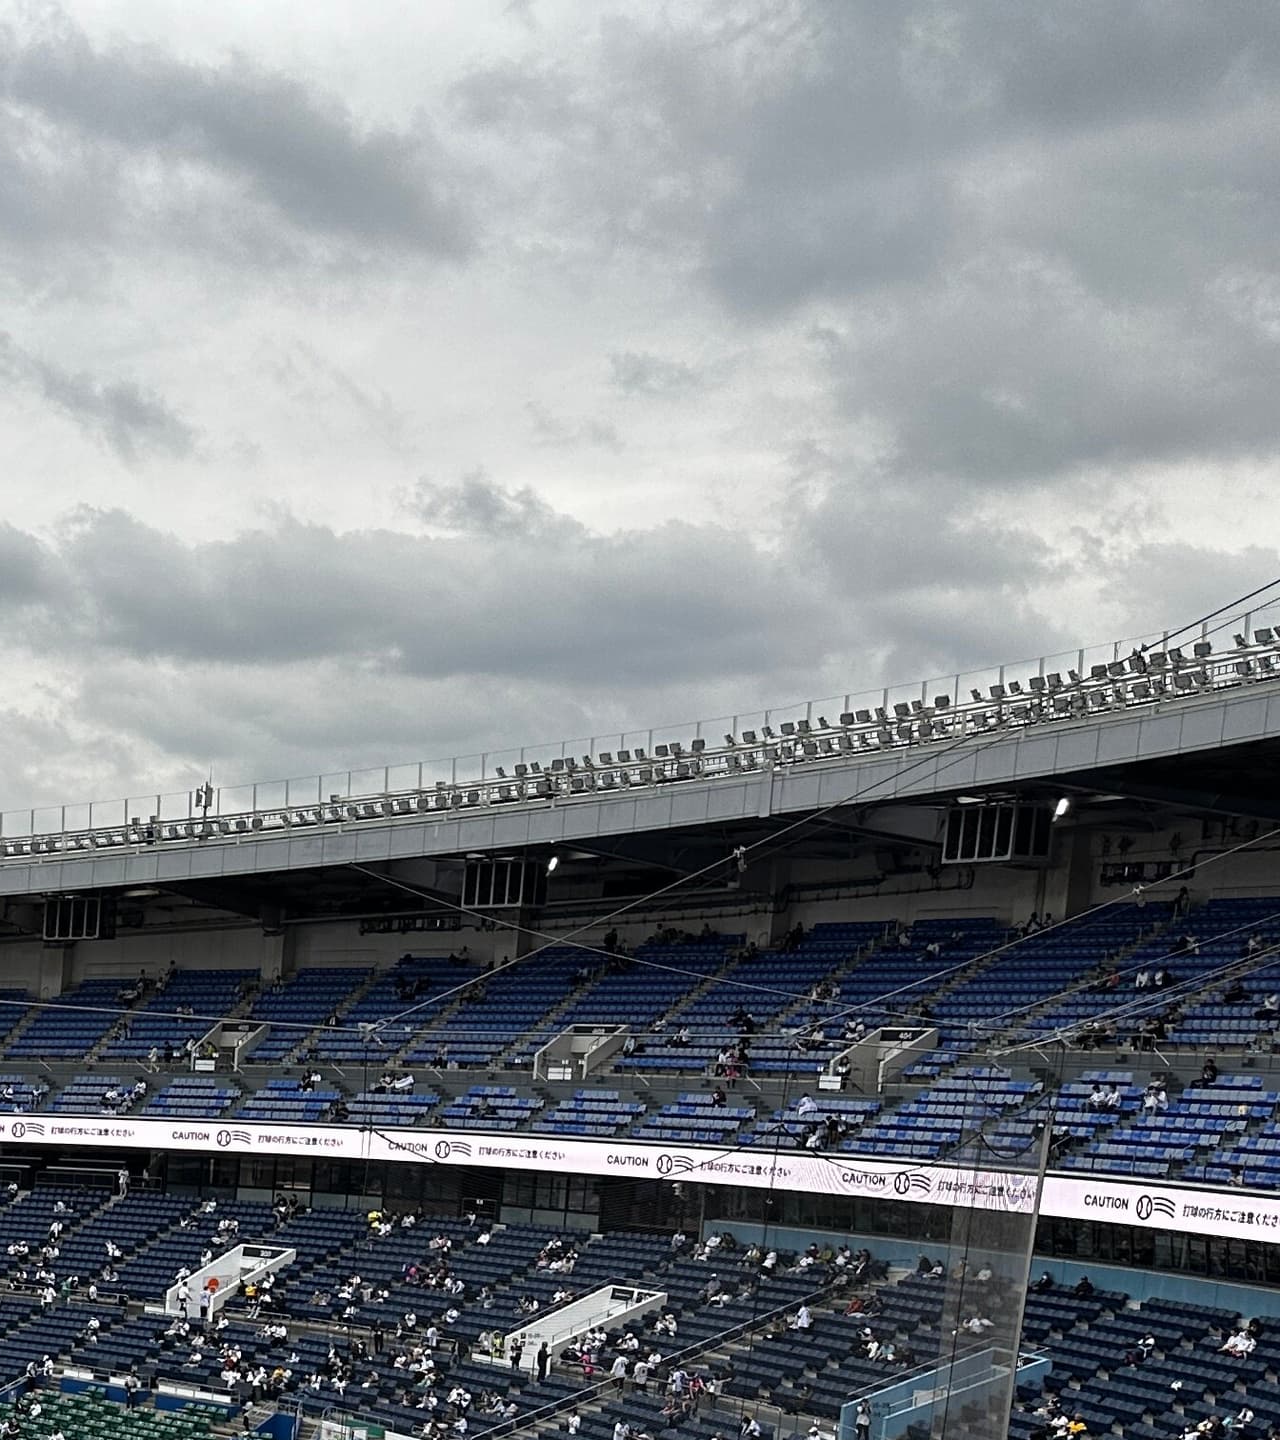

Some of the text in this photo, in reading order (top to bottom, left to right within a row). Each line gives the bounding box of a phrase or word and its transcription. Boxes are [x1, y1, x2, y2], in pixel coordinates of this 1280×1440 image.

[172, 1130, 210, 1142] CAUTION
[388, 1141, 428, 1153] CAUTION
[606, 1154, 649, 1168] CAUTION
[842, 1171, 886, 1187] CAUTION
[1083, 1193, 1130, 1210] CAUTION
